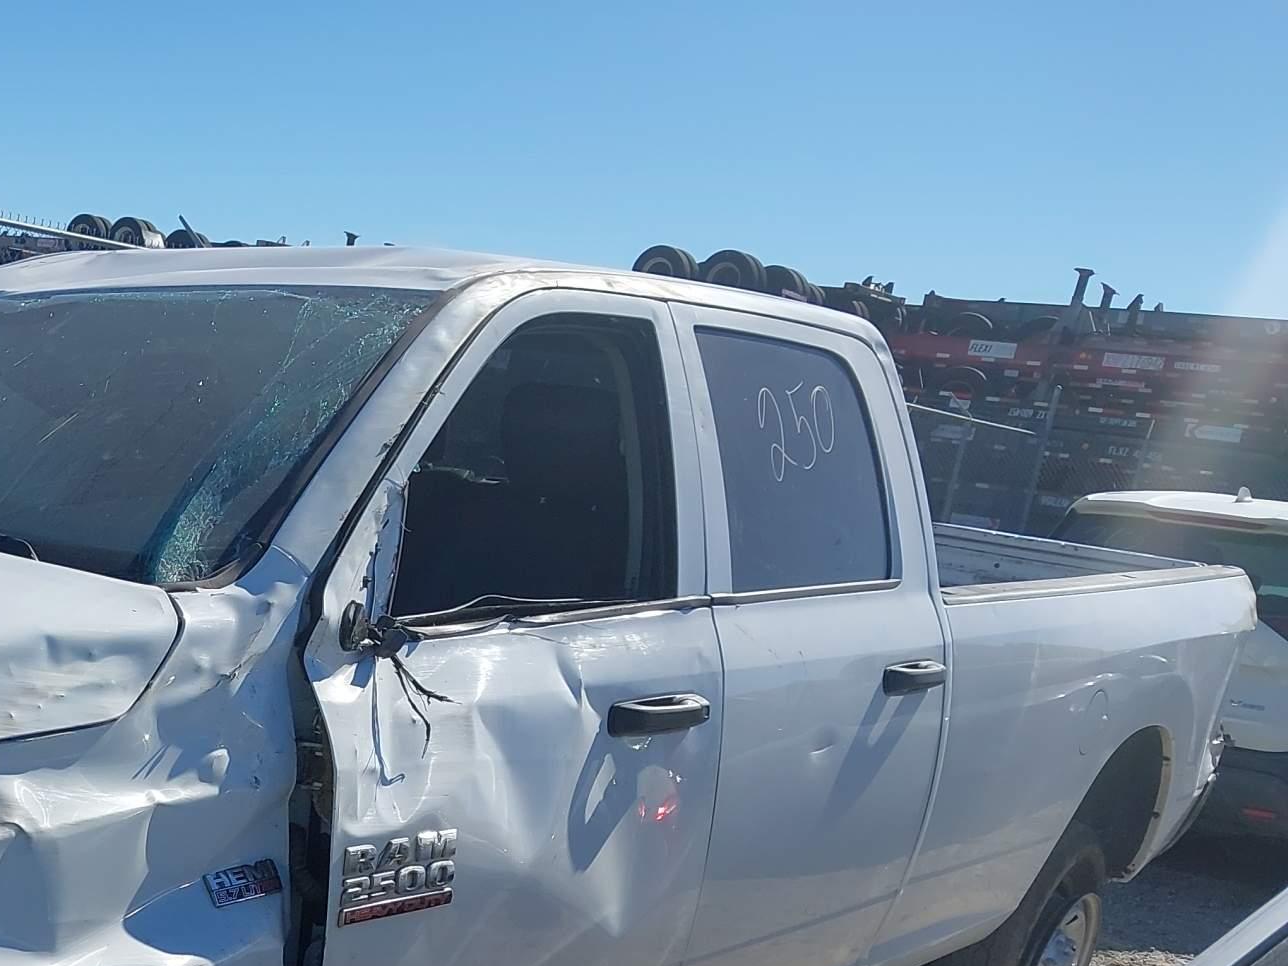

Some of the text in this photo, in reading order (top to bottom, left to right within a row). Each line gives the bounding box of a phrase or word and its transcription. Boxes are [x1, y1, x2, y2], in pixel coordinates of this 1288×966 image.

[757, 379, 835, 483] 250
[343, 827, 459, 876] RAM
[341, 860, 457, 904] 2500
